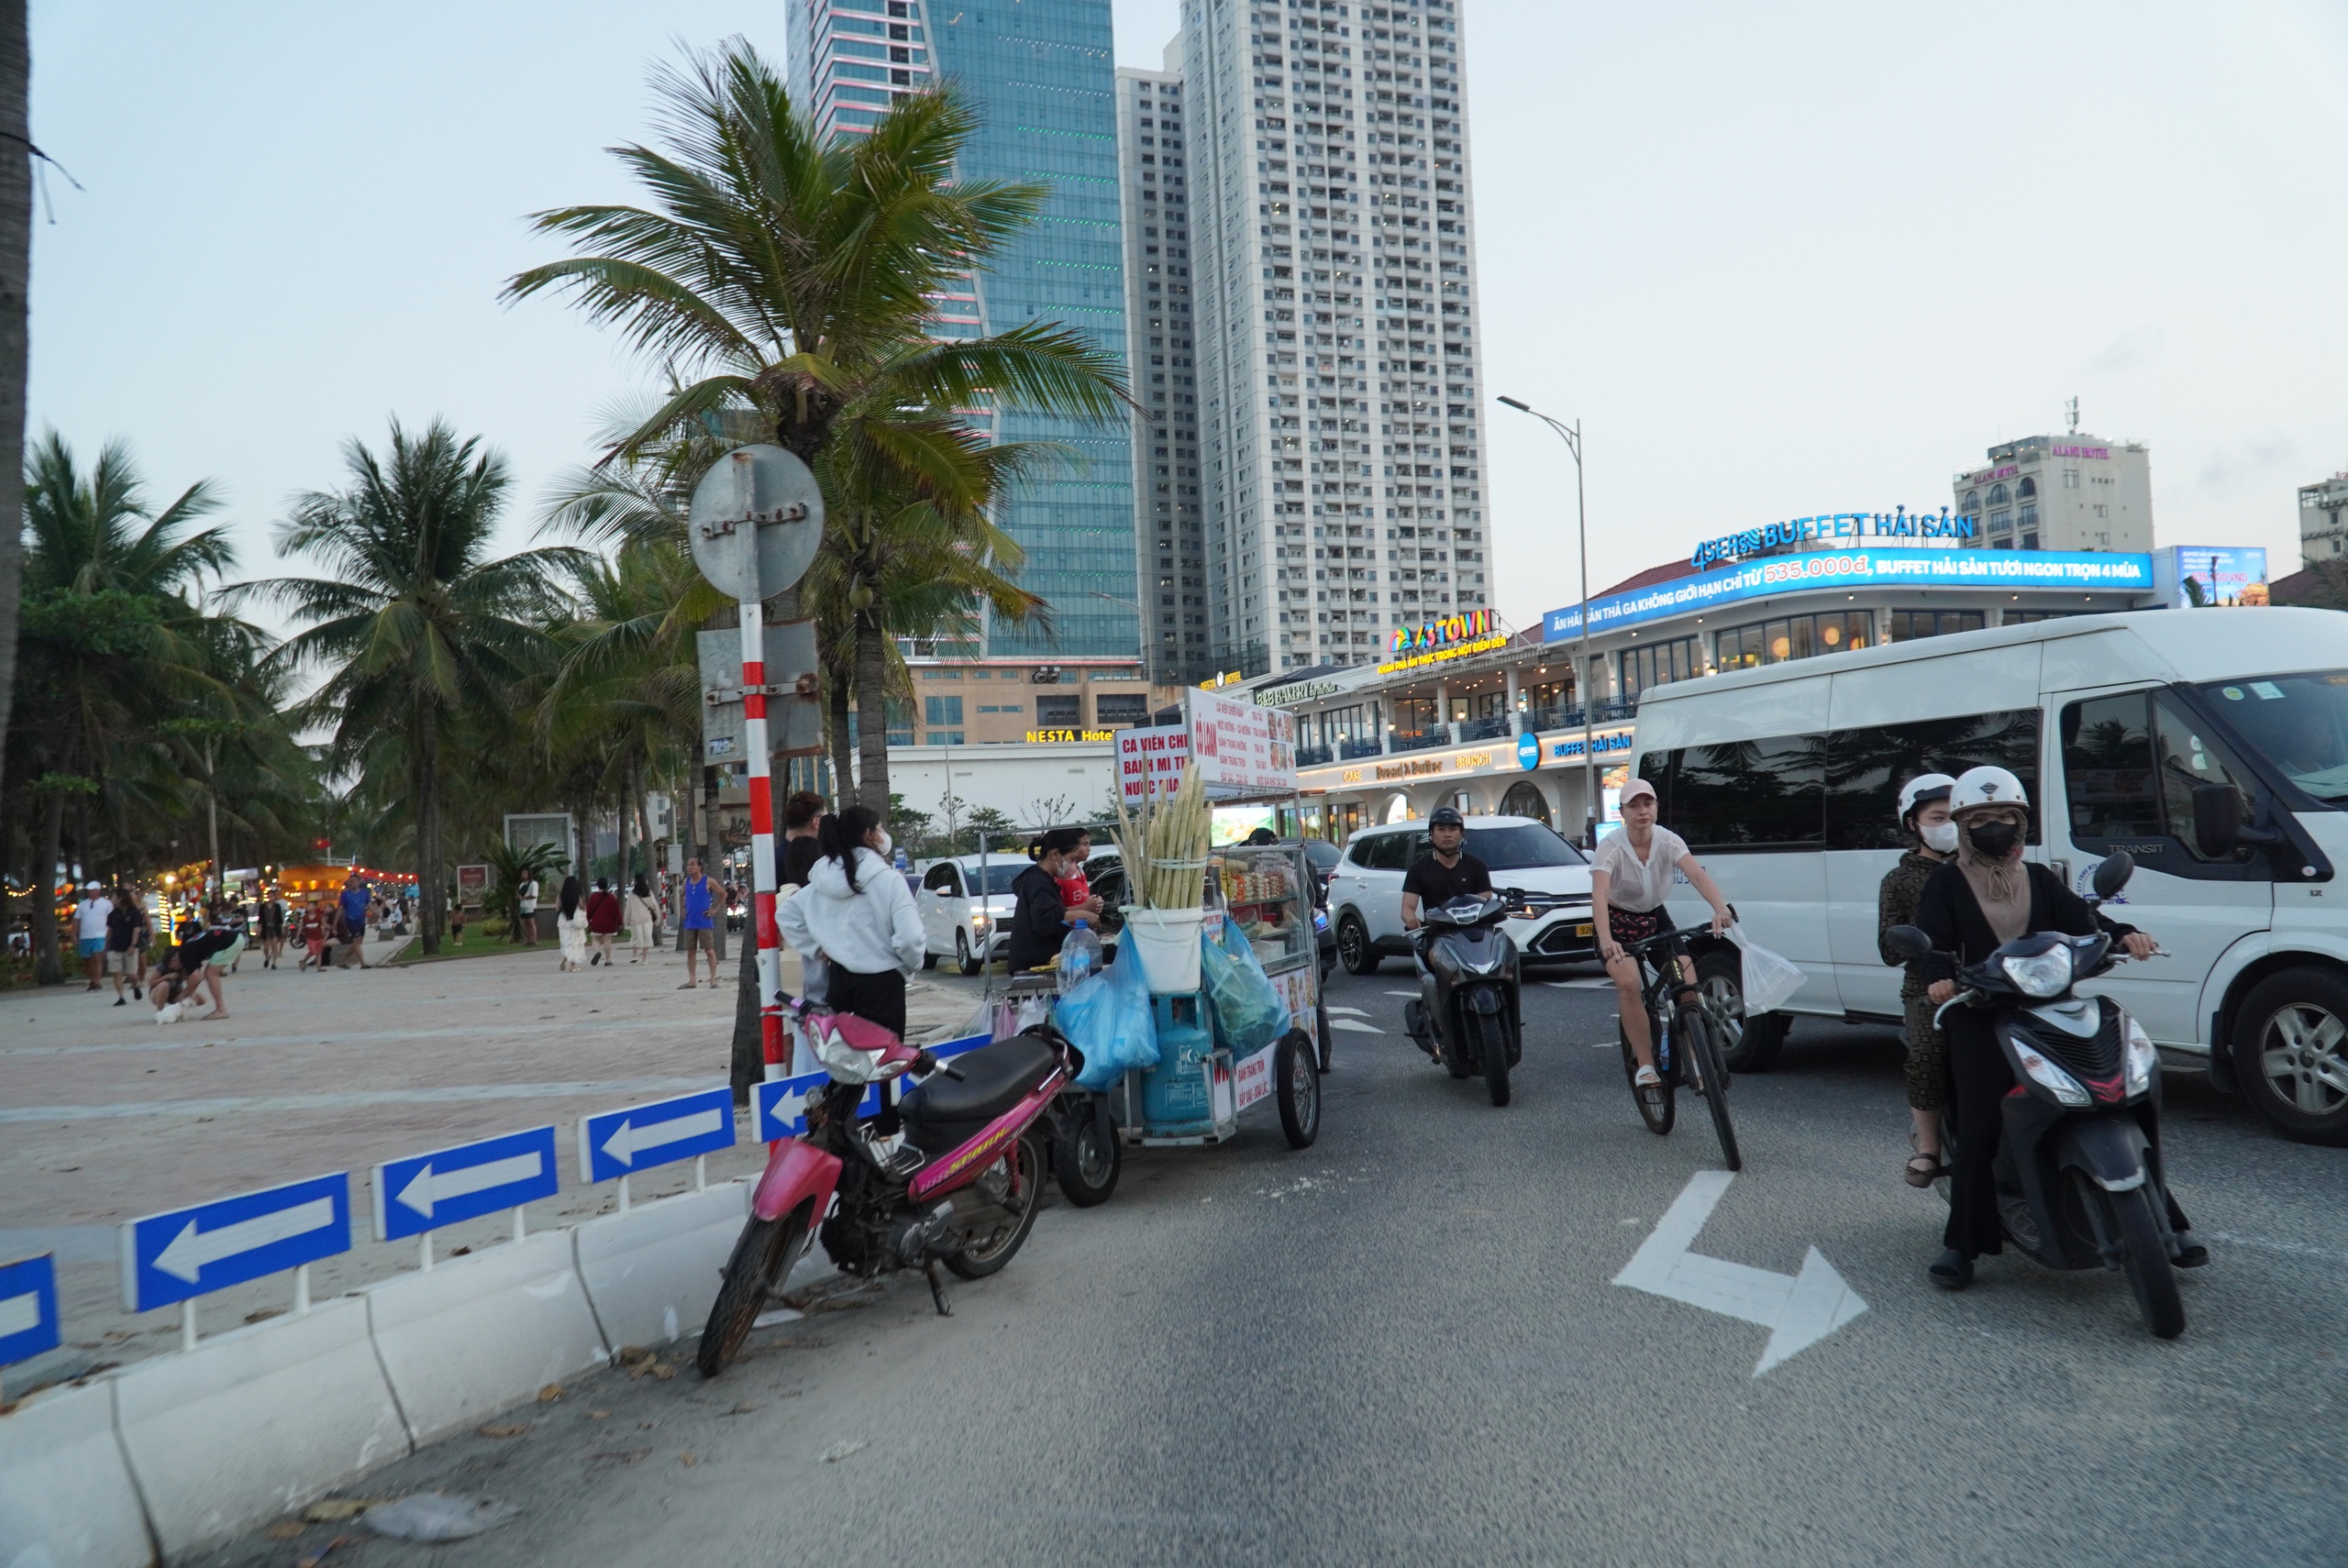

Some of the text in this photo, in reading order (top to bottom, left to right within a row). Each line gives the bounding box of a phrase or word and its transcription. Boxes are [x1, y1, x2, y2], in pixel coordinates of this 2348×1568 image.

[2082, 447, 2110, 460] HOTEL
[1764, 513, 1870, 548] BUFFET
[1876, 504, 1917, 537] HẢI
[1922, 505, 1972, 538] SẢN
[2229, 572, 2248, 582] VND
[1553, 616, 1566, 632] ĂN
[1567, 611, 1583, 628] HẢI
[1603, 601, 1622, 620] THẢ
[1623, 602, 1637, 615] GA
[1638, 592, 1675, 612] KHÔNG
[1675, 583, 1697, 603] GIỚI
[1698, 580, 1722, 599] HẠN
[1722, 571, 1742, 592] CHỈ
[1743, 569, 1763, 587] TỪ
[1876, 560, 1931, 574] BUFFET
[1932, 556, 1958, 575] HẢI
[1958, 557, 1988, 575] SẢN
[1988, 559, 2023, 576] TƯƠI
[2023, 562, 2064, 577] NGON
[2064, 563, 2101, 581] TRỌN
[2102, 564, 2110, 577] 4
[1415, 608, 1492, 648] 43TOWN
[1377, 662, 1395, 675] KHÁM
[1395, 658, 1408, 671] PHÁ
[1418, 651, 1435, 666] THỰC
[1435, 649, 1457, 661] TRONG
[1457, 642, 1473, 657] MỘT
[1225, 671, 1243, 685] HOTEL
[1257, 691, 1275, 707] B&B
[1275, 681, 1312, 704] BAKERY
[1026, 730, 1074, 743] NESTA
[1123, 736, 1137, 753] CÁ
[1140, 734, 1165, 751] VIÊN
[1592, 735, 1609, 753] HẢI
[1609, 732, 1632, 750] SẢN
[1157, 755, 1171, 771] MÌ
[1455, 753, 1492, 768] BRUNCH
[1343, 770, 1362, 782] CAKE
[1376, 760, 1443, 780] Bread & Butter
[2108, 844, 2165, 853] TRANSIT
